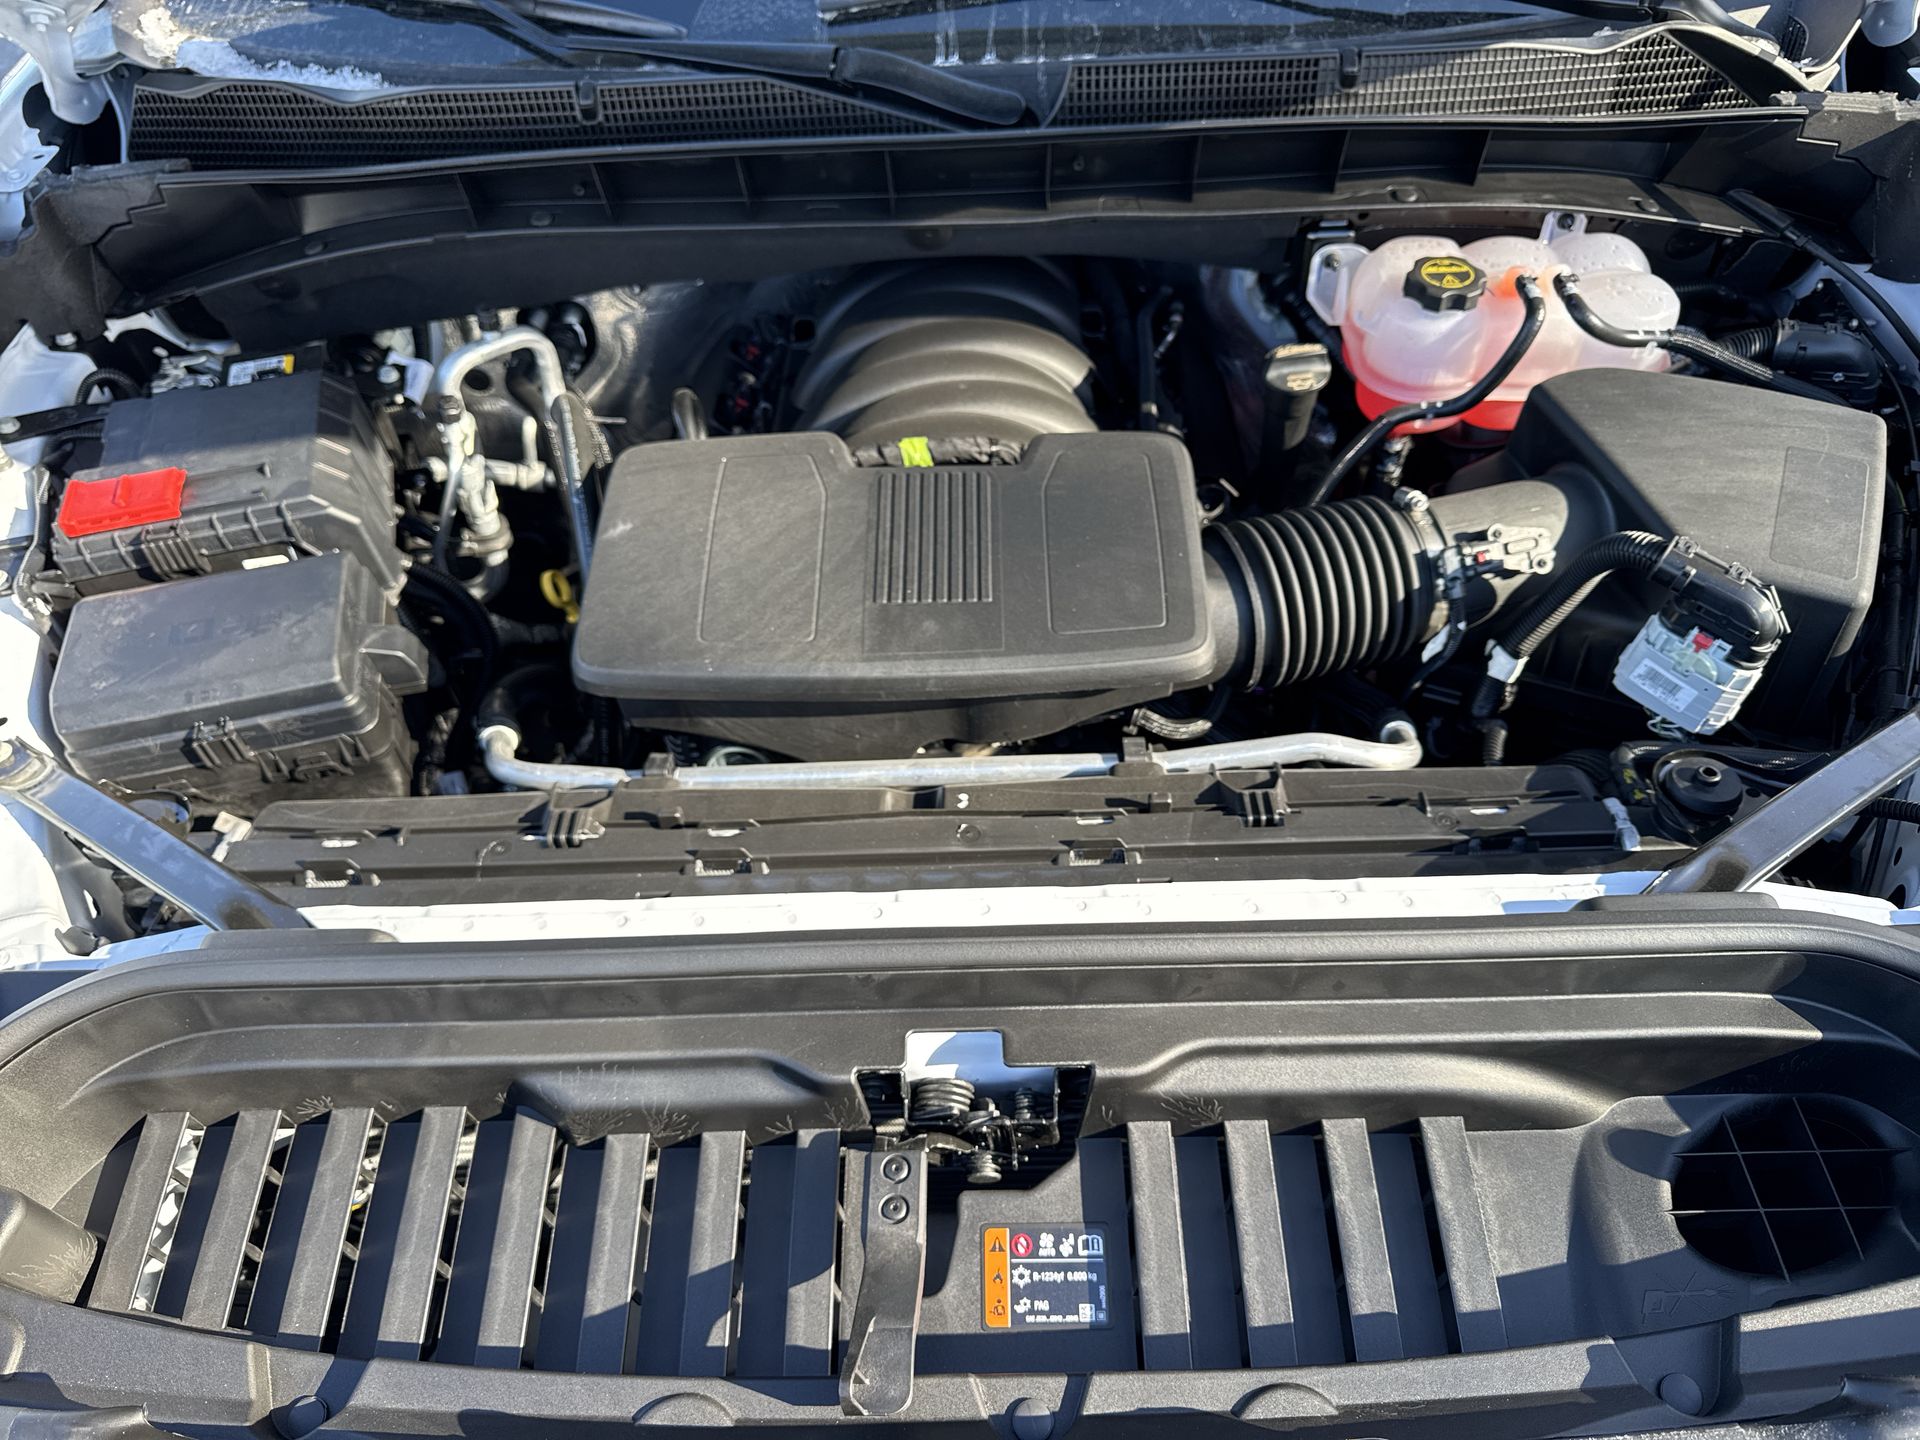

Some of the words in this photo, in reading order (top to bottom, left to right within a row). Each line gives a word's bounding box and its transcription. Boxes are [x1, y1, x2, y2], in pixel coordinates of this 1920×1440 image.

[1032, 1271, 1065, 1284] R-1234yf
[1088, 1272, 1098, 1283] kg
[1033, 1299, 1050, 1312] PAG
